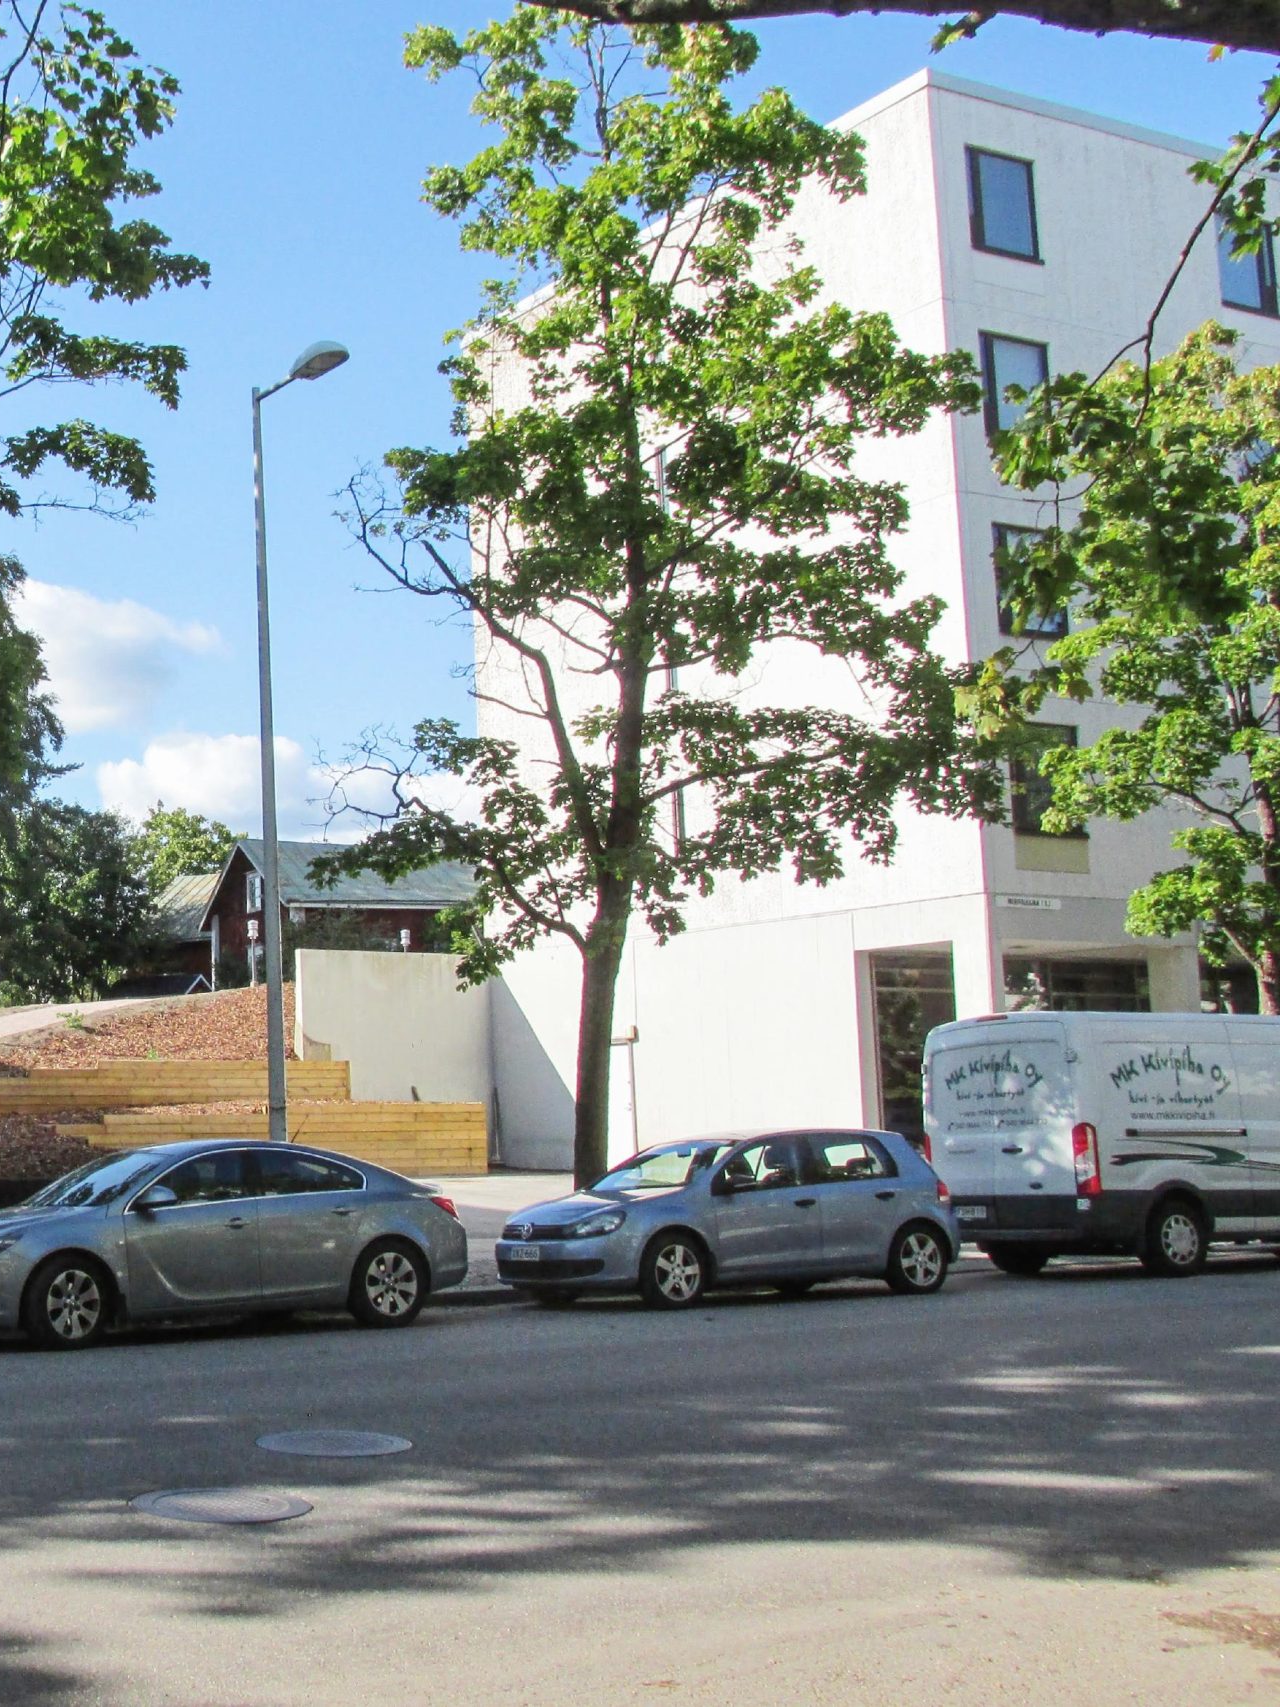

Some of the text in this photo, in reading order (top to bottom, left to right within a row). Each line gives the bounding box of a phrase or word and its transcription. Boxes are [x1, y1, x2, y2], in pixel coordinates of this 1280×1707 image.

[945, 1065, 967, 1090] MK
[1024, 1063, 1044, 1088] Oy
[1109, 1045, 1231, 1095] MK Kivipiha Oy
